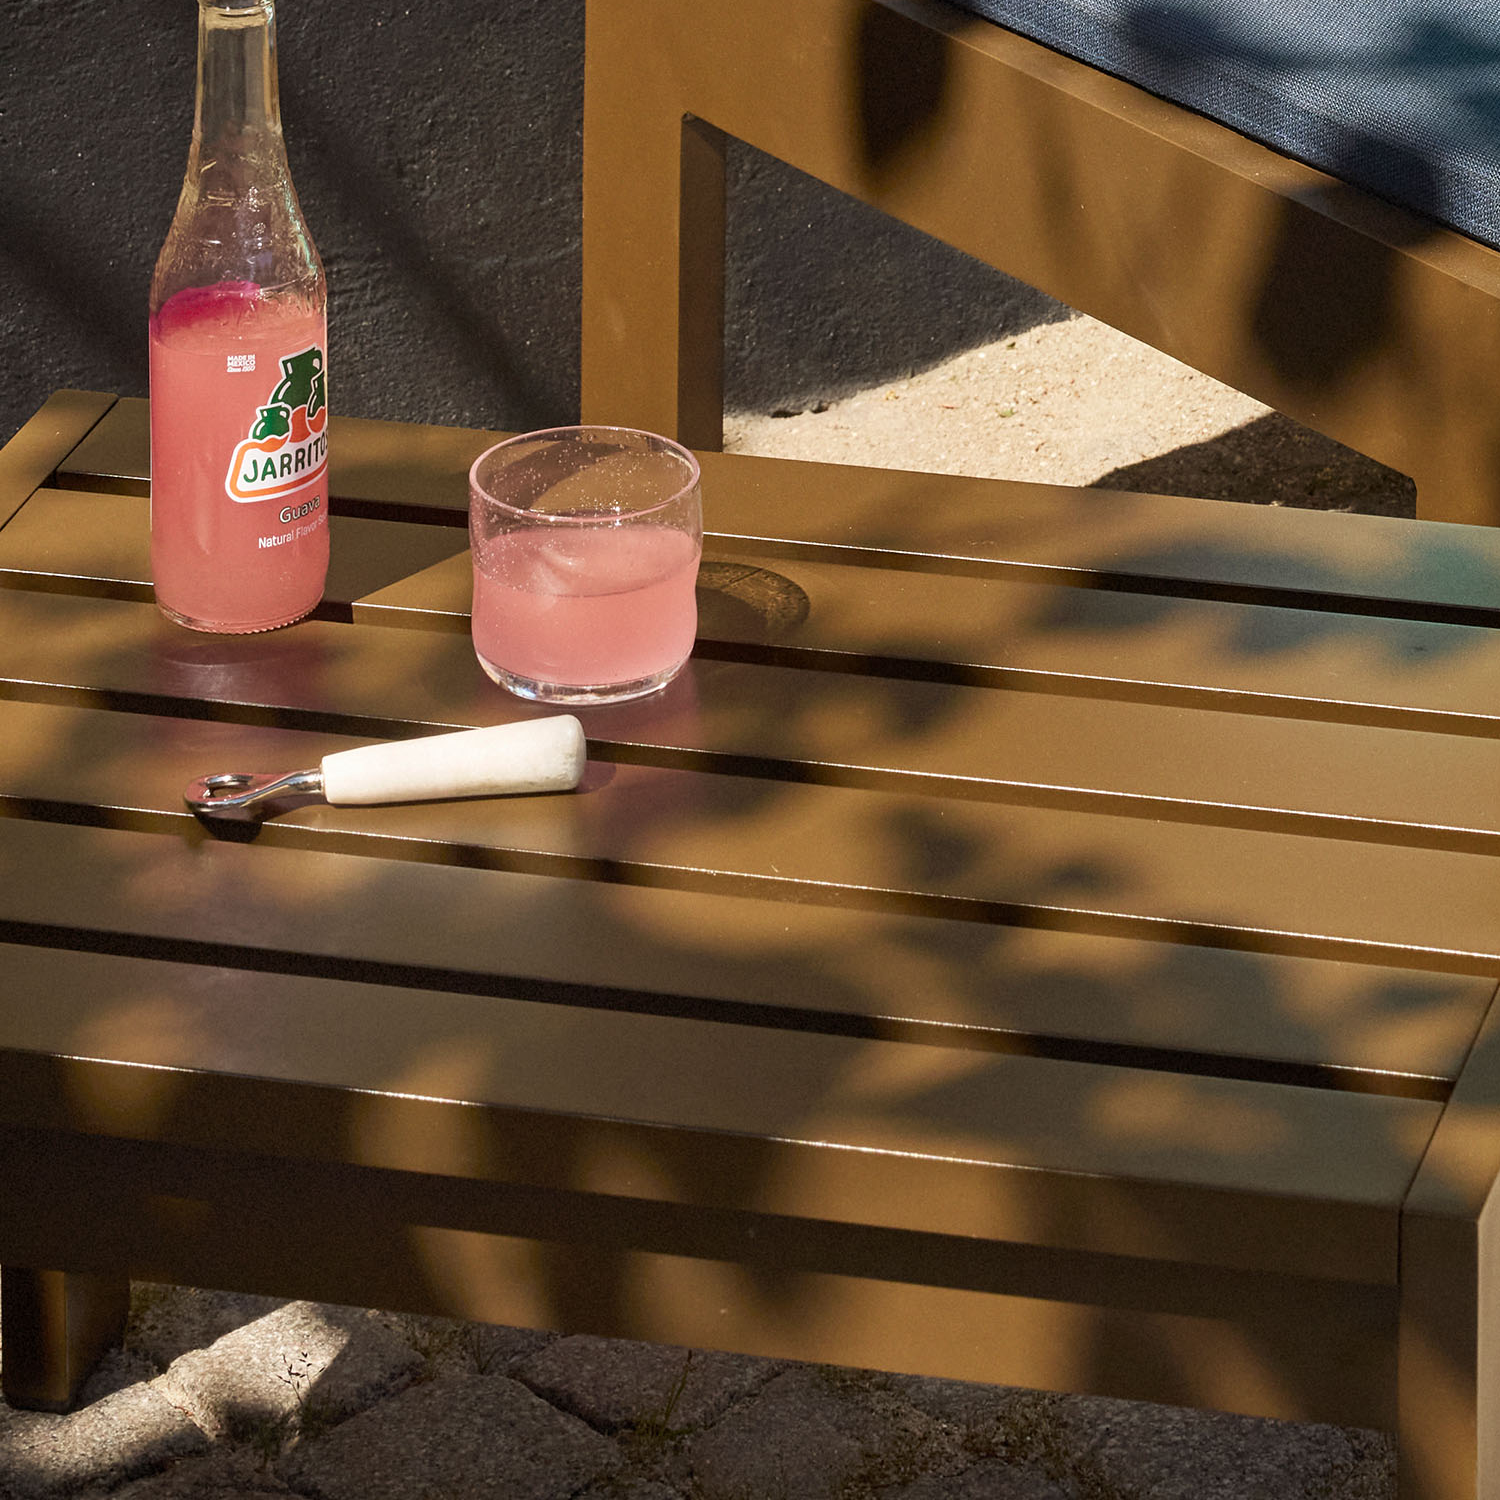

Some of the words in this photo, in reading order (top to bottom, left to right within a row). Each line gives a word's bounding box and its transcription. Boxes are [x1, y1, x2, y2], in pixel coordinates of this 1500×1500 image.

[279, 495, 320, 524] Guava
[258, 529, 294, 549] Natural
[296, 520, 317, 539] Flavor
